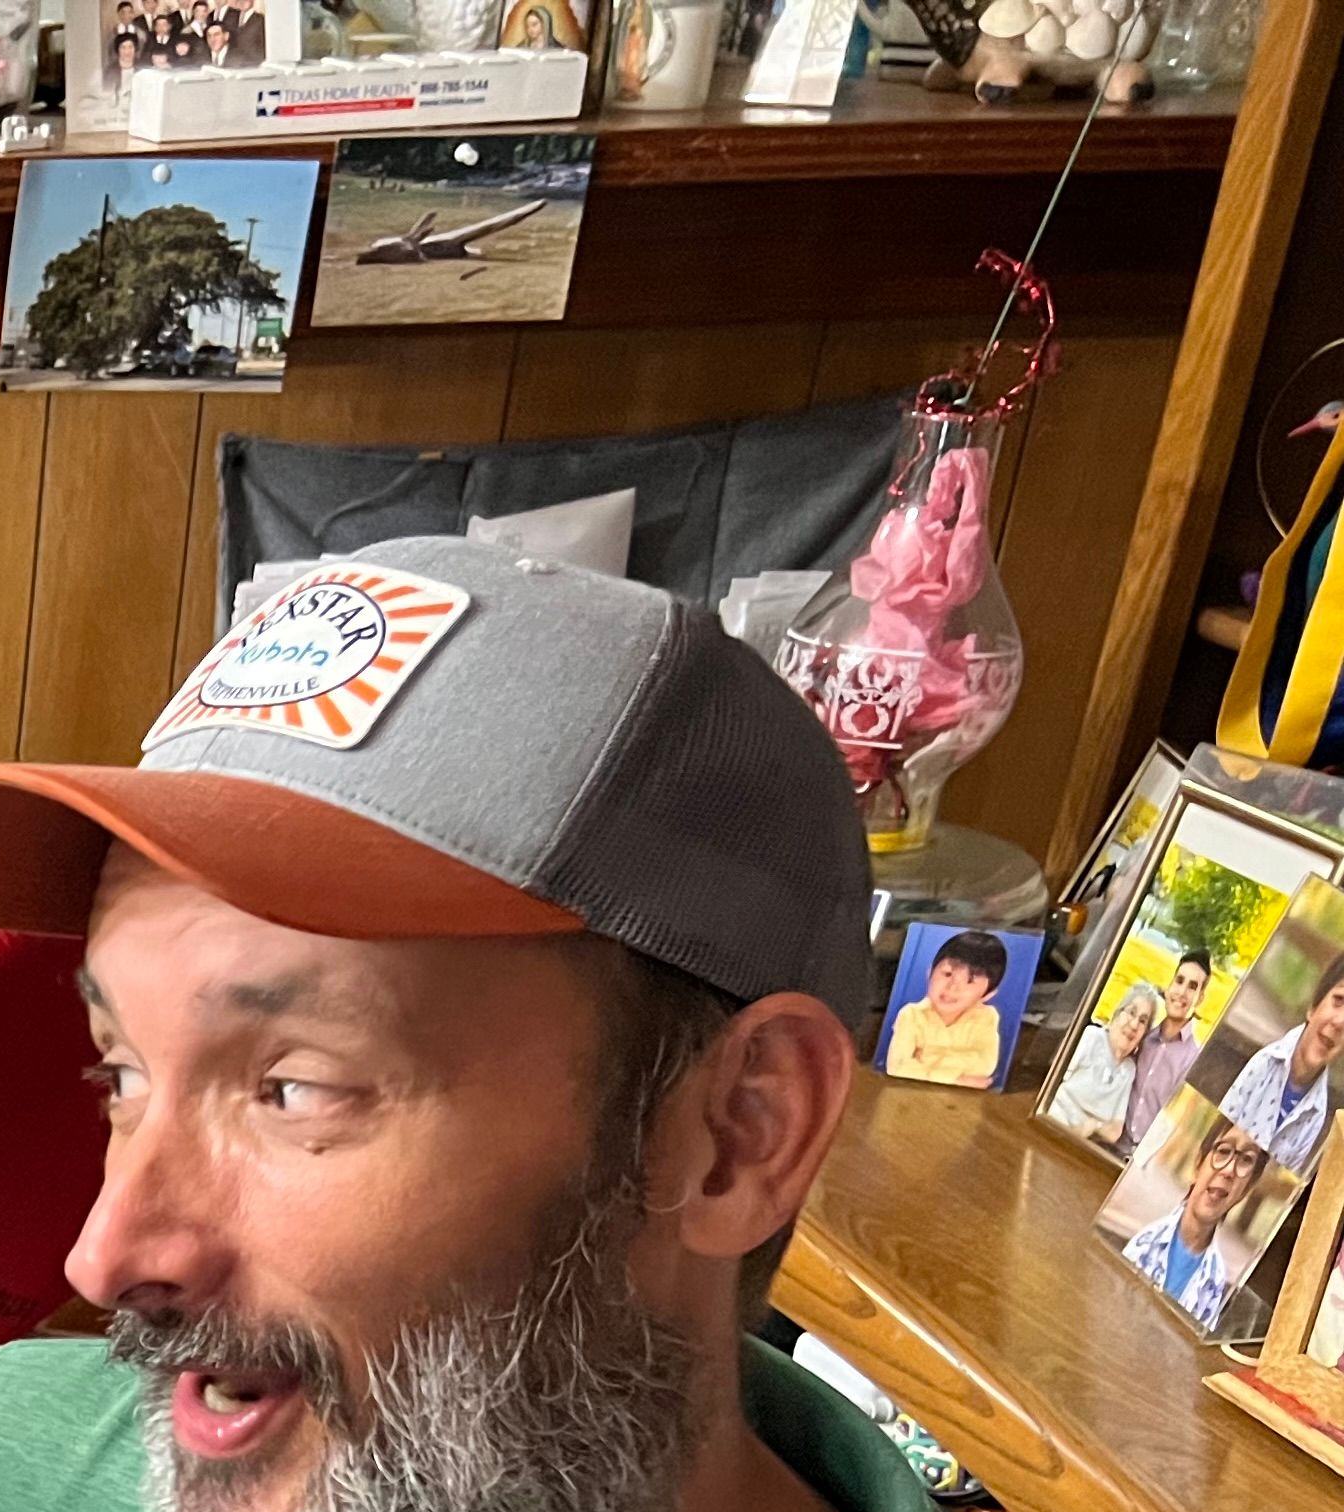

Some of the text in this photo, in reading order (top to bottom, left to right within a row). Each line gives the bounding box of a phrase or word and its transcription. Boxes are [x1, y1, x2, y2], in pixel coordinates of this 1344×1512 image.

[285, 83, 410, 102] TEXAS HOME HEALTH
